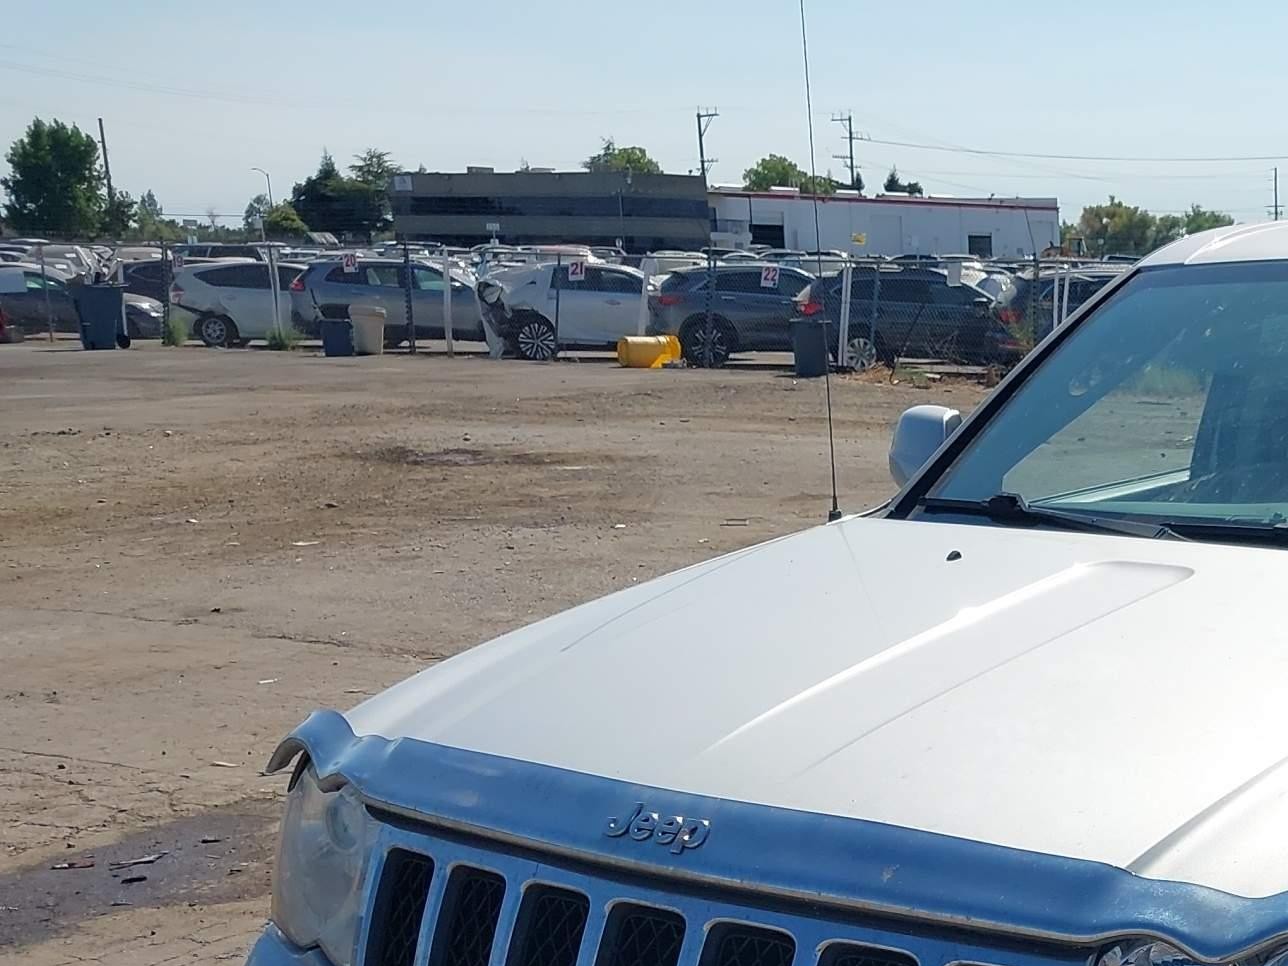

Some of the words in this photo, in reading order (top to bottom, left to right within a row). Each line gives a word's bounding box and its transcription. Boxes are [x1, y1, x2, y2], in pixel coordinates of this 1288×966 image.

[344, 254, 357, 268] 20
[570, 262, 584, 276] 21
[763, 267, 778, 282] 22
[603, 801, 712, 855] Jeep
